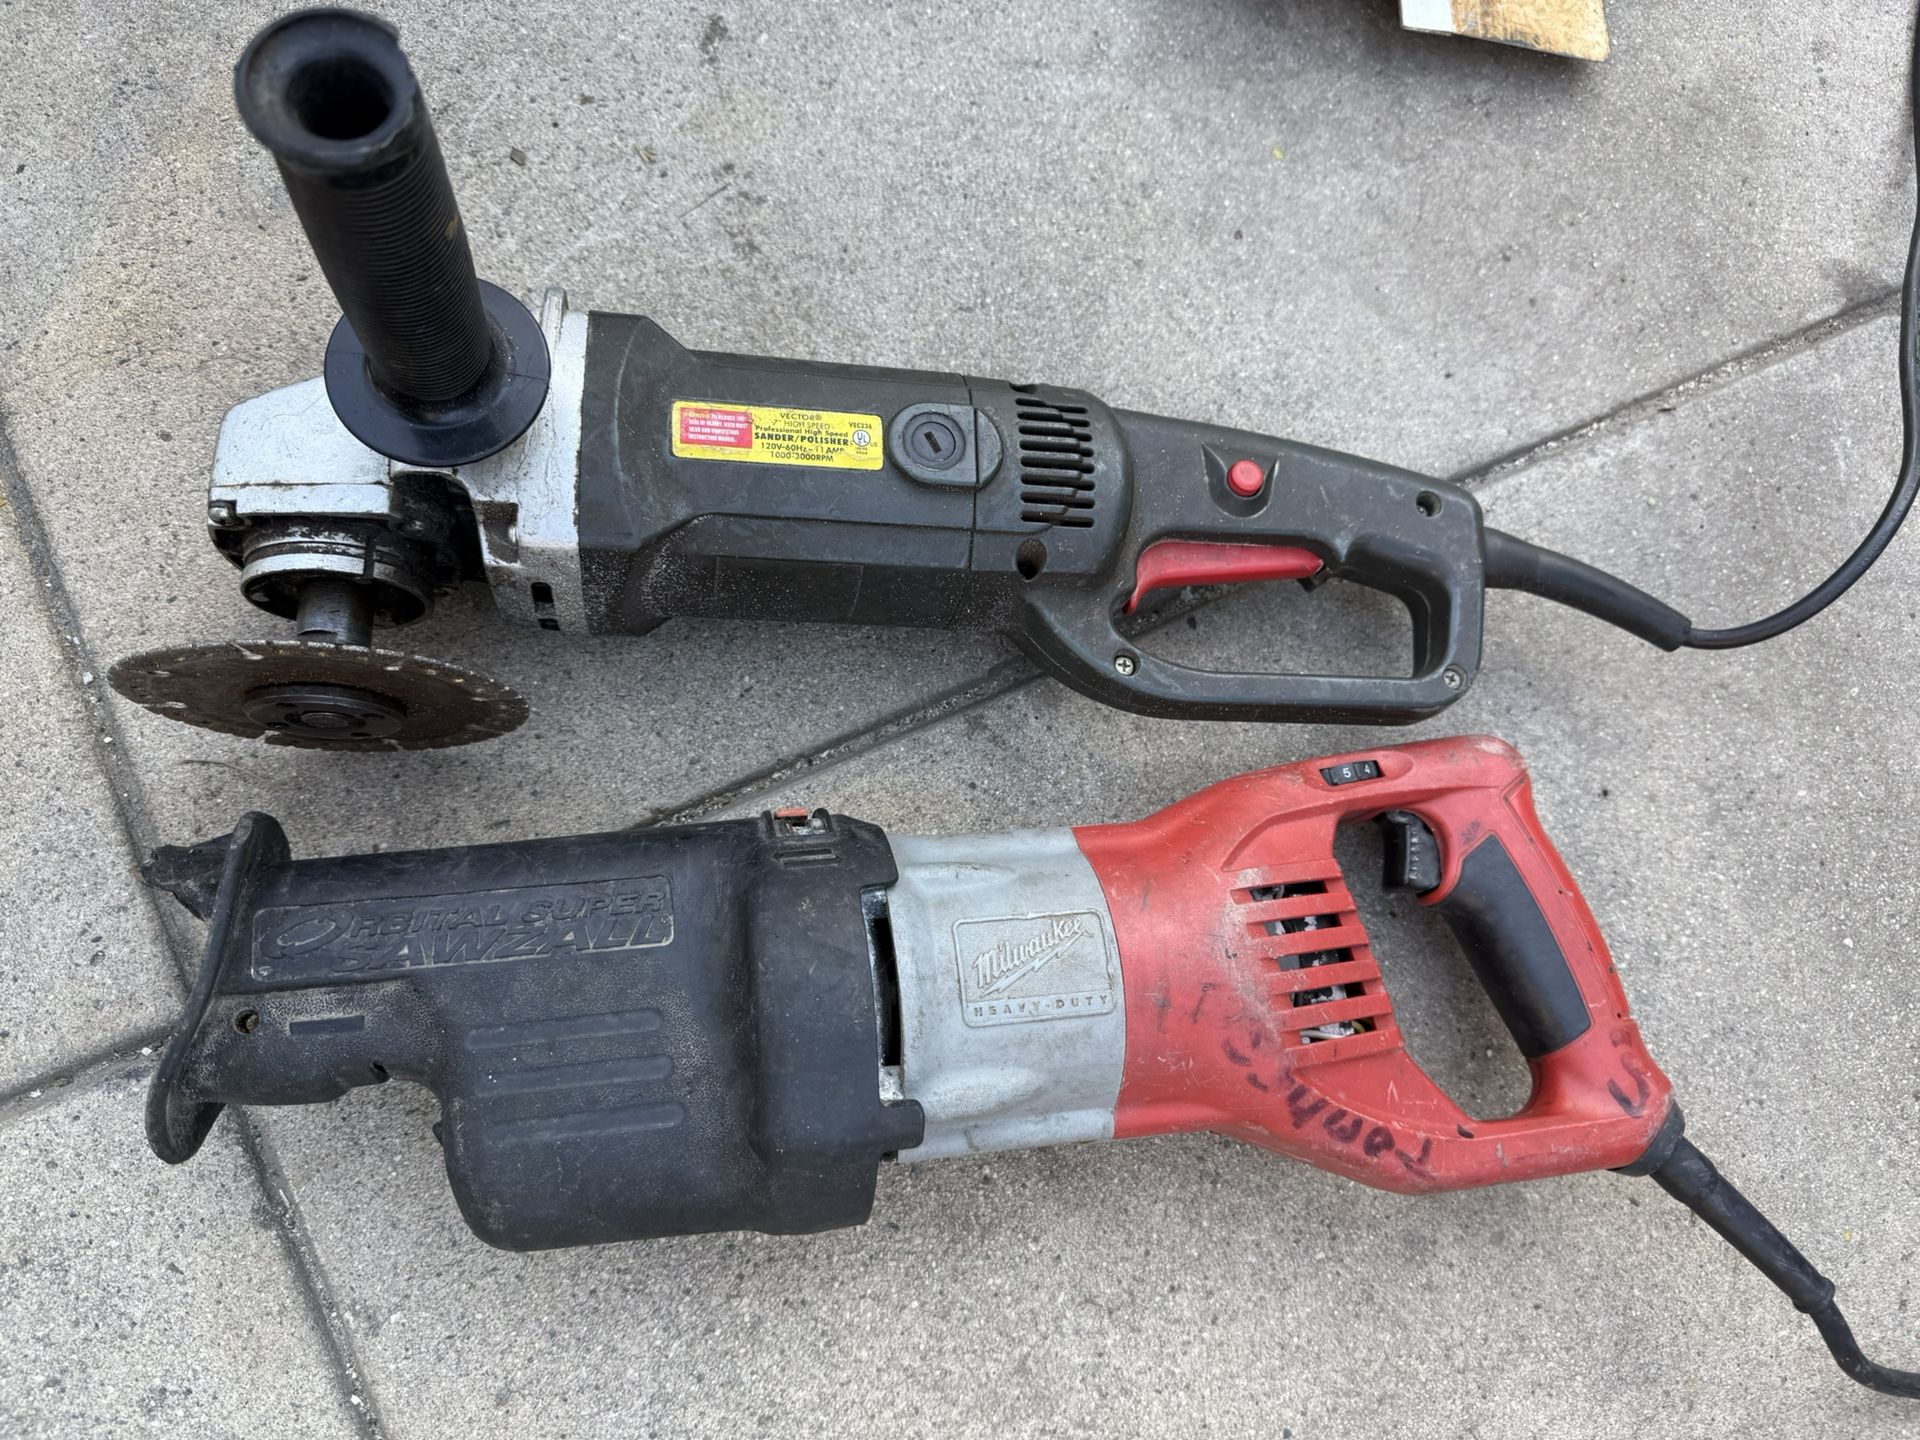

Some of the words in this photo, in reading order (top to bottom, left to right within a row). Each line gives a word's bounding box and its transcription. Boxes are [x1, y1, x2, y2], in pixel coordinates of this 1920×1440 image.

[755, 424, 802, 434] Professional
[805, 428, 822, 437] High
[825, 430, 849, 438] Speed
[807, 421, 831, 430] SPEED
[754, 432, 849, 446] SANDER/POLISHER
[1342, 767, 1352, 778] 5
[1364, 764, 1371, 774] 4
[521, 892, 666, 923] SUPER
[972, 917, 1087, 989] Milwaukee
[973, 994, 1109, 1018] HEAVY-DUTY
